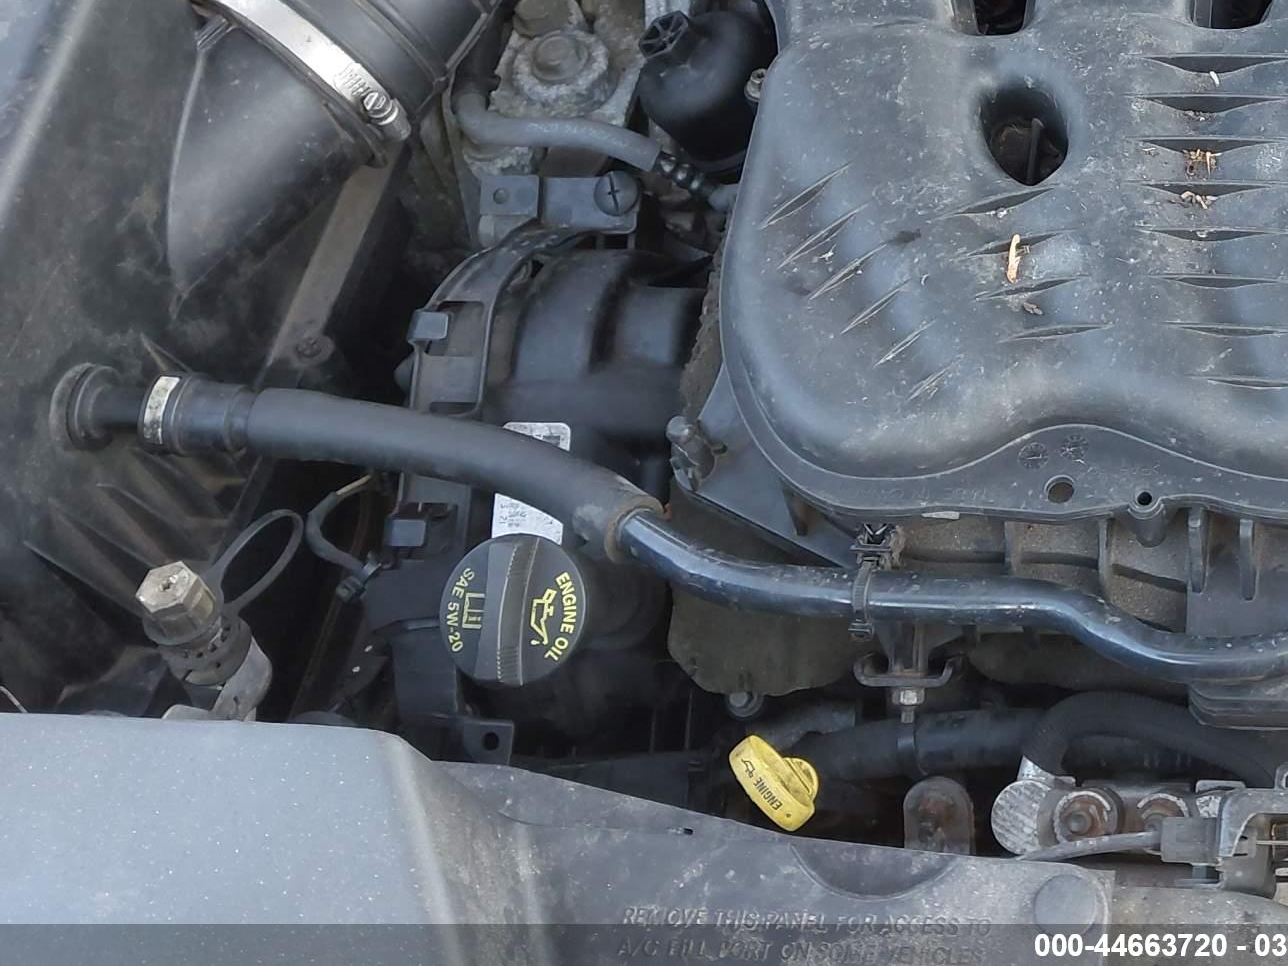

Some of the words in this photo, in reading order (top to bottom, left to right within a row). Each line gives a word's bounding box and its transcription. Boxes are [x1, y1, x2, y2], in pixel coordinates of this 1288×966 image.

[451, 568, 475, 599] SAE
[555, 572, 577, 634] ENGINE
[446, 601, 464, 652] 5W-20
[544, 637, 569, 661] OIL
[753, 777, 783, 810] ENGINE
[622, 906, 709, 928] REMOVE
[714, 908, 760, 931] THIS
[836, 914, 877, 933] FOR
